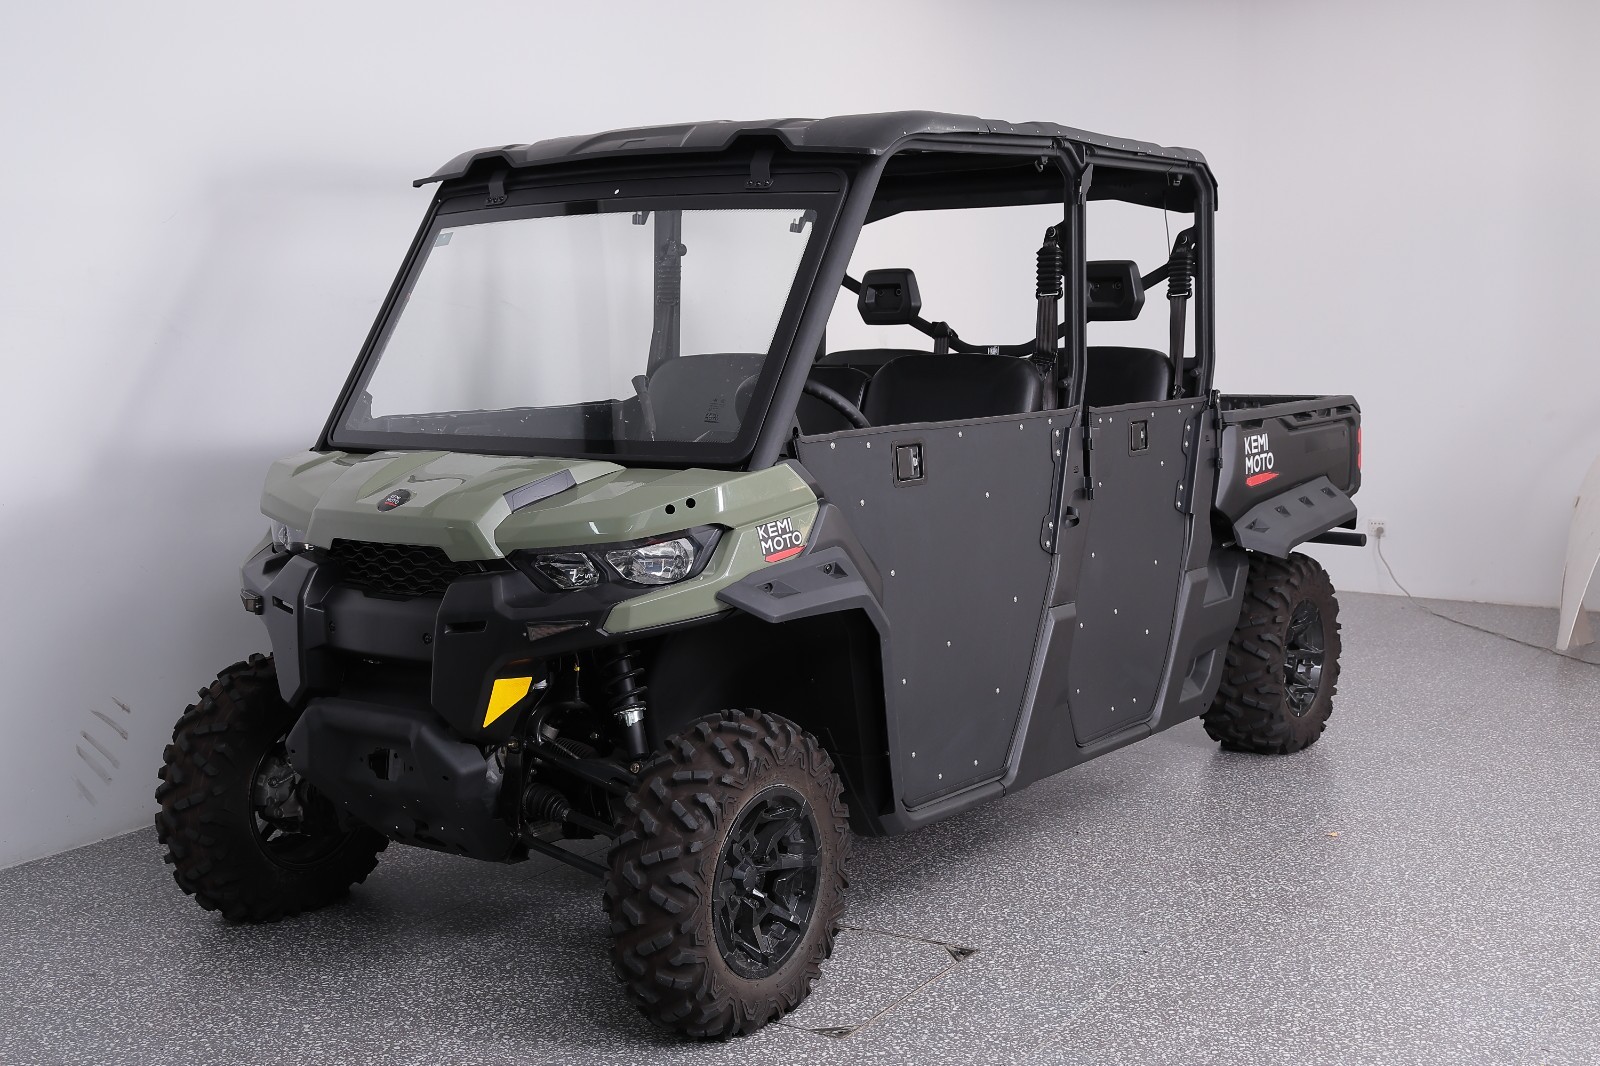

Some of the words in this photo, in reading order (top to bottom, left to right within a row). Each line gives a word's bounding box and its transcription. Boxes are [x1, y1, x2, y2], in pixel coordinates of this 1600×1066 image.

[1244, 433, 1269, 455] KEMI
[1245, 451, 1274, 475] MOTO
[756, 517, 793, 540] KEMI
[760, 531, 802, 555] MOTO
